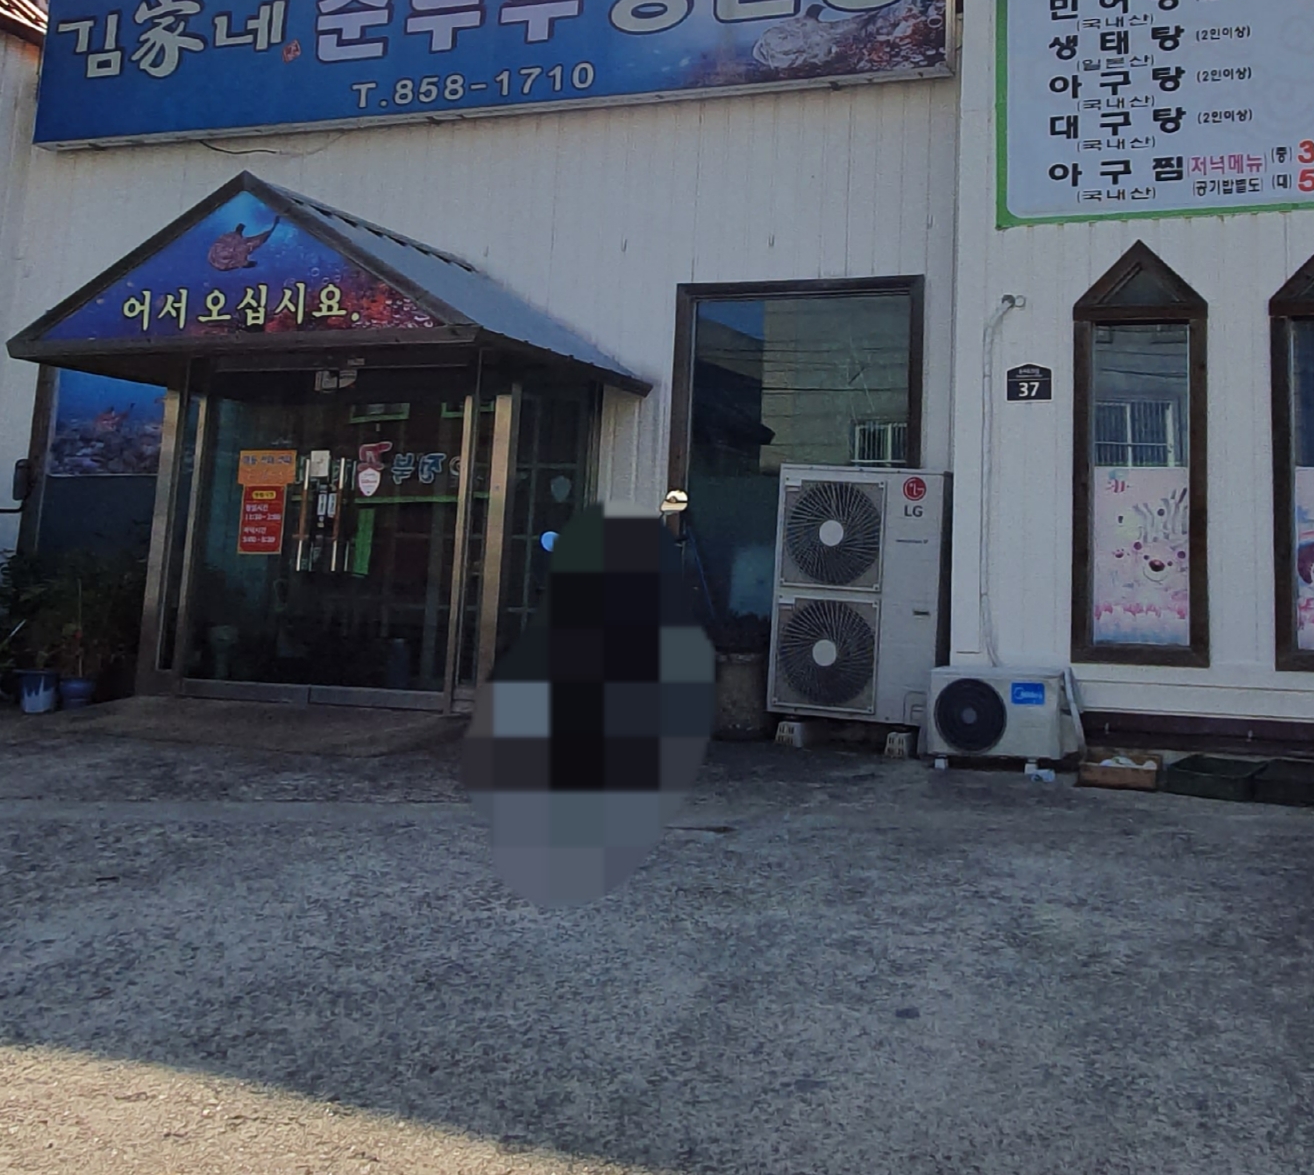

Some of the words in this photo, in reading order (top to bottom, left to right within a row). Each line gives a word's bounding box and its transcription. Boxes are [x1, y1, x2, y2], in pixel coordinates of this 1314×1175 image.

[1196, 25, 1251, 41] (2인이상)
[1197, 67, 1252, 83] (2인이상)
[351, 60, 597, 110] T.858-1710
[1198, 109, 1253, 125] (2인이상)
[1018, 381, 1040, 397] 37
[904, 504, 924, 518] LG
